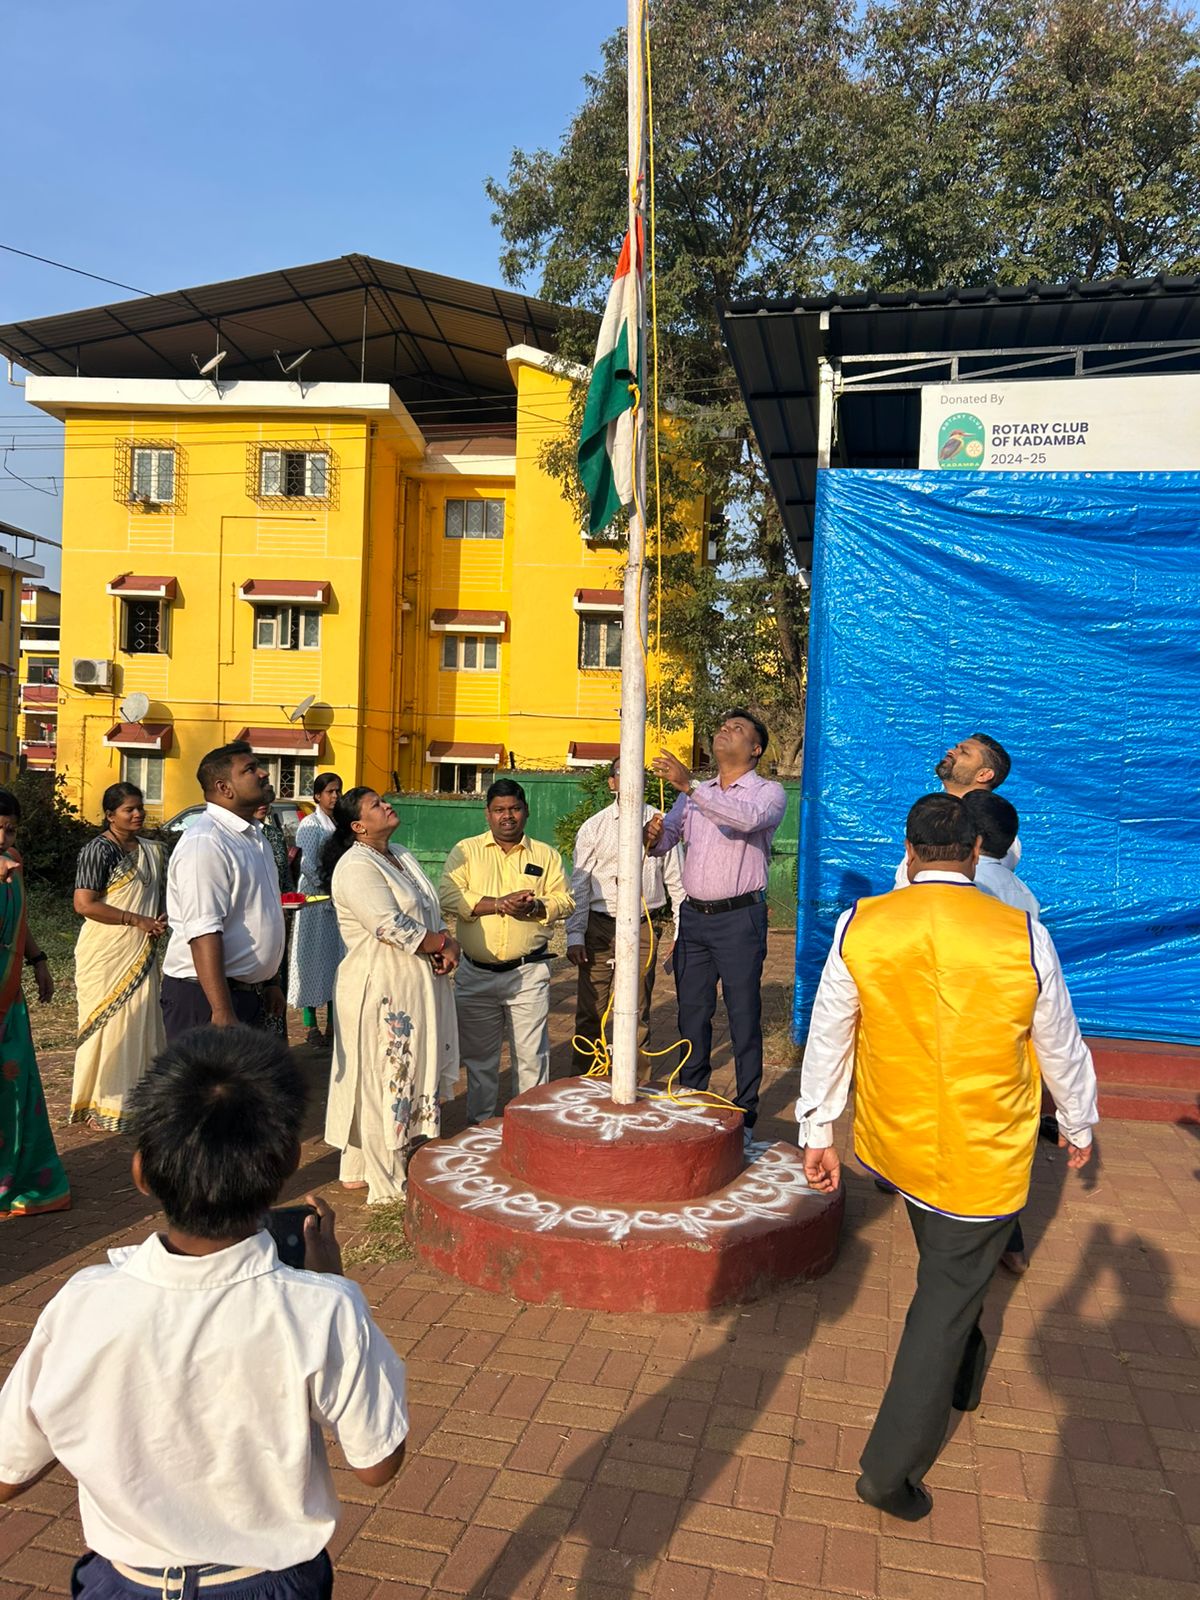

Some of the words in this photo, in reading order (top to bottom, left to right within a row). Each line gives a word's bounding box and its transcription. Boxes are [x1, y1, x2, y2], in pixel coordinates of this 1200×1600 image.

[941, 394, 987, 405] Donated
[990, 393, 1005, 405] By
[992, 423, 1049, 435] ROTARY
[1052, 422, 1089, 433] CLUB
[992, 436, 1010, 447] OF
[1013, 434, 1086, 447] KADAMBA
[991, 453, 1047, 465] 2024-25
